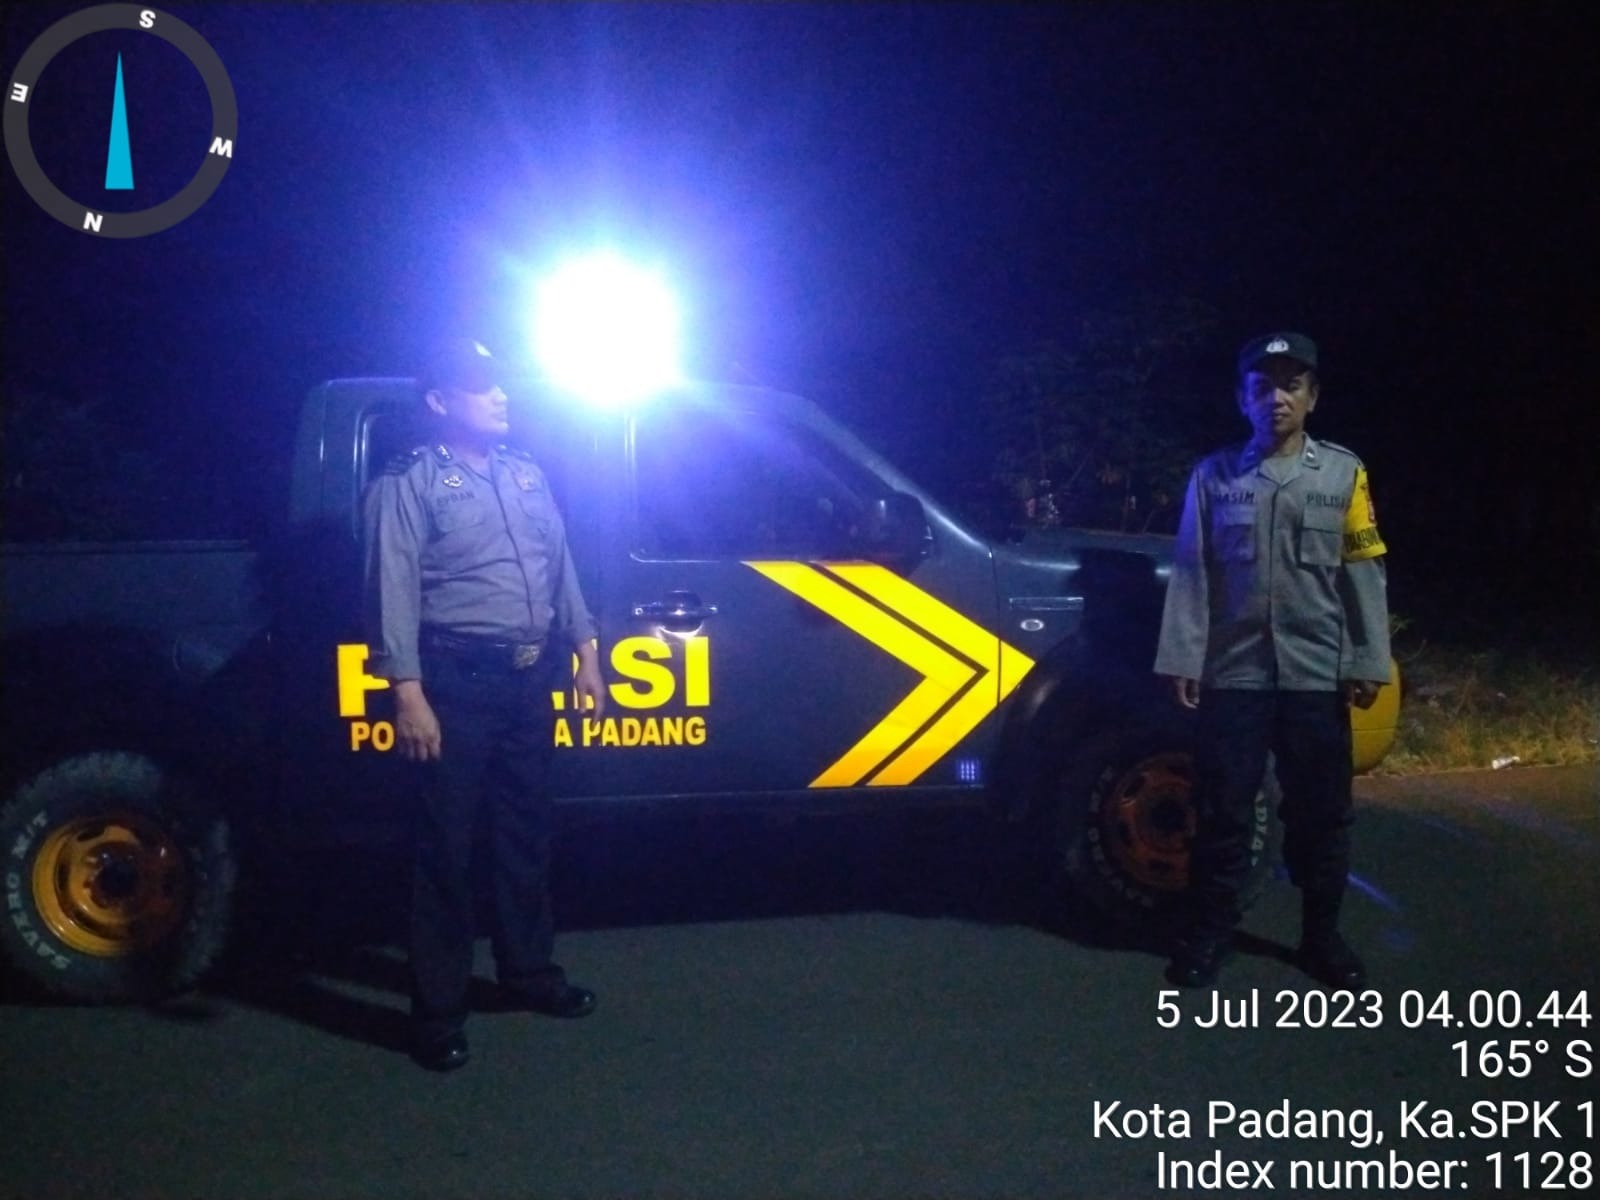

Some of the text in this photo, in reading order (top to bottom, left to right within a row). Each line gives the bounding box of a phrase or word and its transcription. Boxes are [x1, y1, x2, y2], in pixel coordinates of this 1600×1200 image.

[351, 716, 707, 752] PO A PADANG
